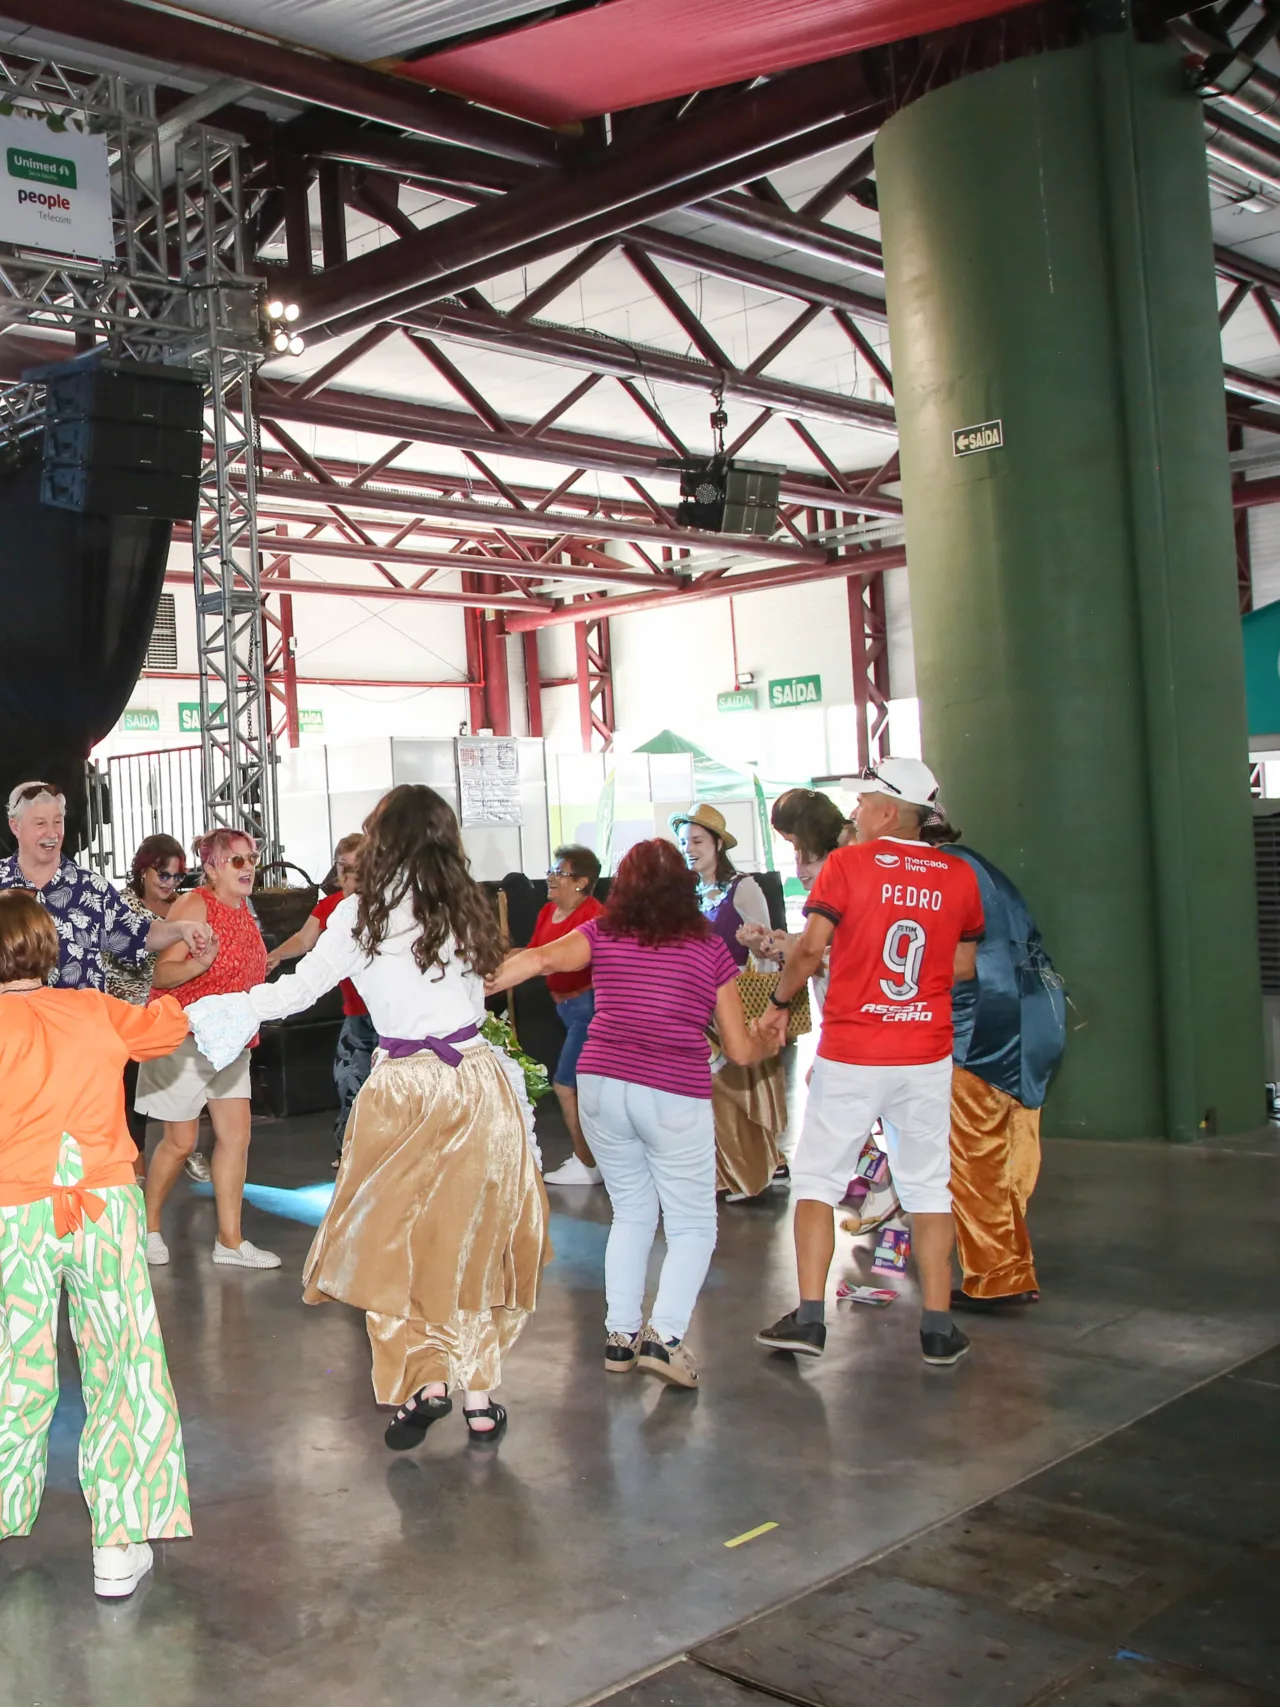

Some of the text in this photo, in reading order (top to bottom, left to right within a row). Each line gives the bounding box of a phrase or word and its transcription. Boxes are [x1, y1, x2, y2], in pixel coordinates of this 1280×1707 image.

[14, 155, 57, 173] Unimed
[18, 189, 70, 210] people
[38, 210, 71, 225] Telecom
[969, 426, 1000, 450] SAÍDA
[718, 692, 752, 709] SAÍDA
[772, 680, 817, 706] SAÍDA
[126, 712, 157, 728] SAÍDA
[904, 856, 948, 870] mercado
[905, 862, 926, 873] livre
[881, 883, 942, 911] PEDRO
[905, 925, 917, 933] TIM
[879, 918, 926, 1002] 9
[882, 1012, 933, 1022] CARD
